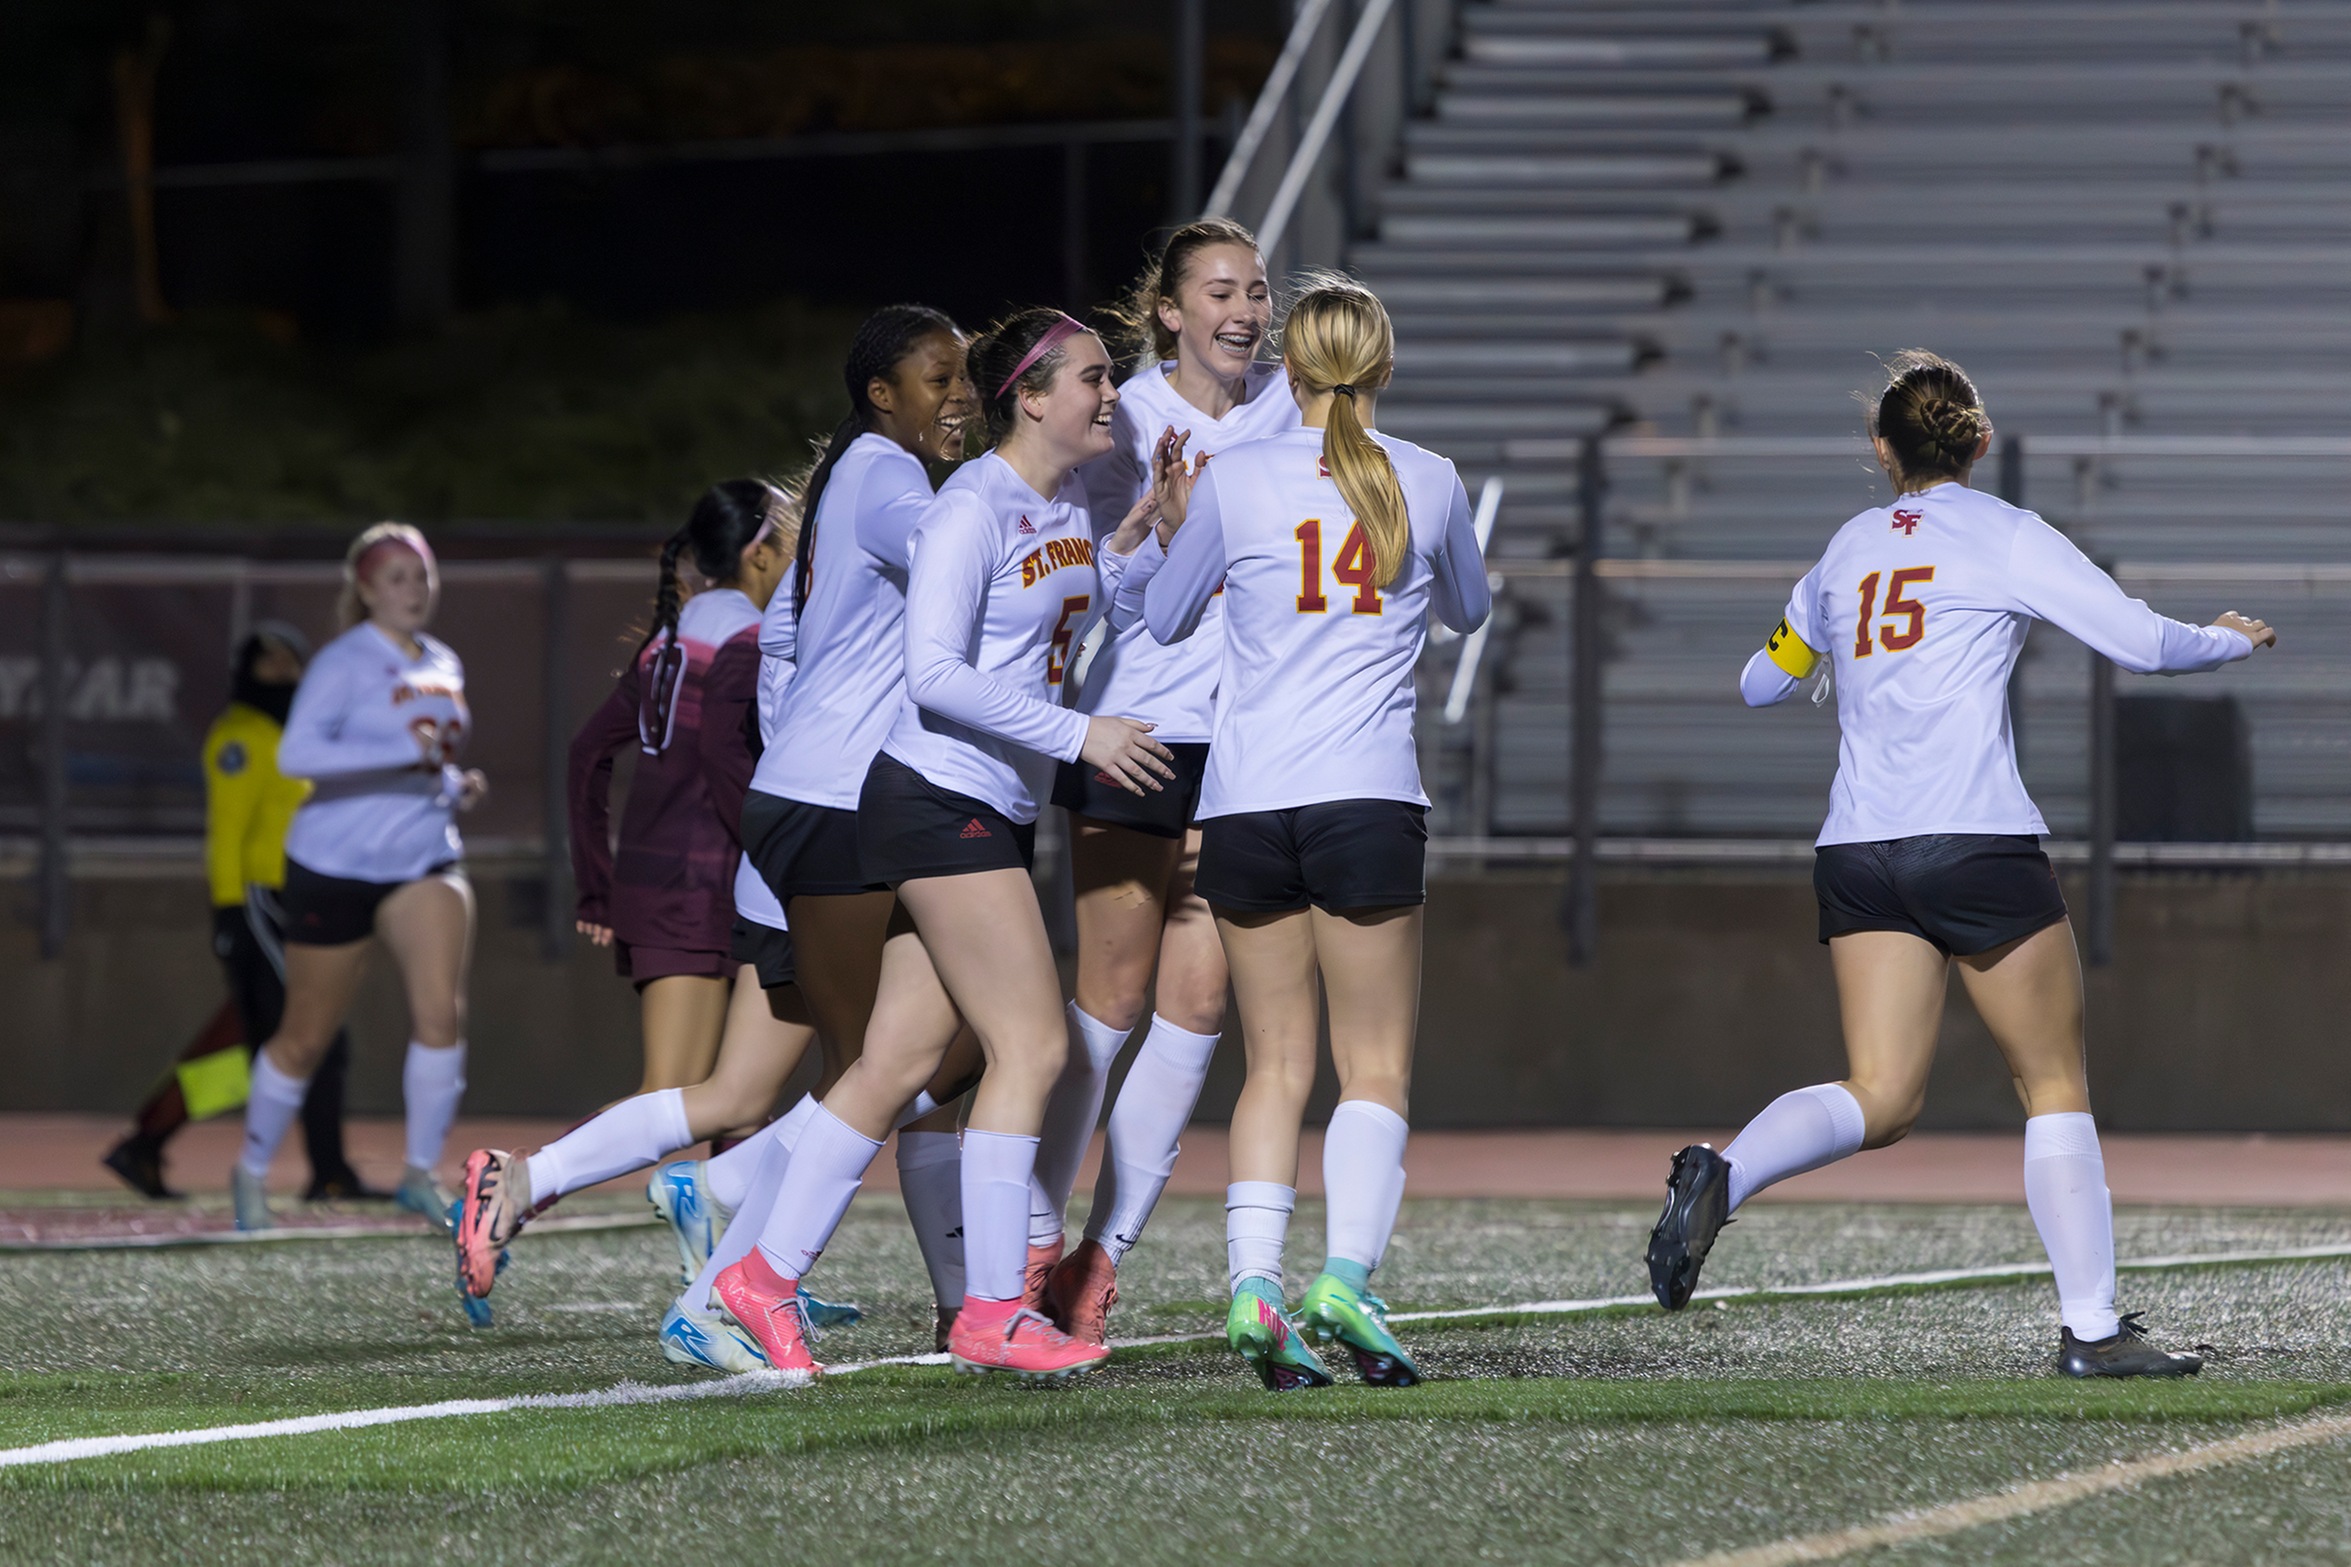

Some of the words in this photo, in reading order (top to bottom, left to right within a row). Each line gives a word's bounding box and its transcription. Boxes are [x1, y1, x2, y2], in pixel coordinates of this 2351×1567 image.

[1890, 509, 1924, 537] SF
[1021, 546, 1051, 590] ST.
[1294, 518, 1383, 616] 14
[1046, 593, 1090, 686] 5
[1768, 617, 1788, 652] C
[1854, 565, 1936, 660] 15
[0, 655, 180, 722] YAR
